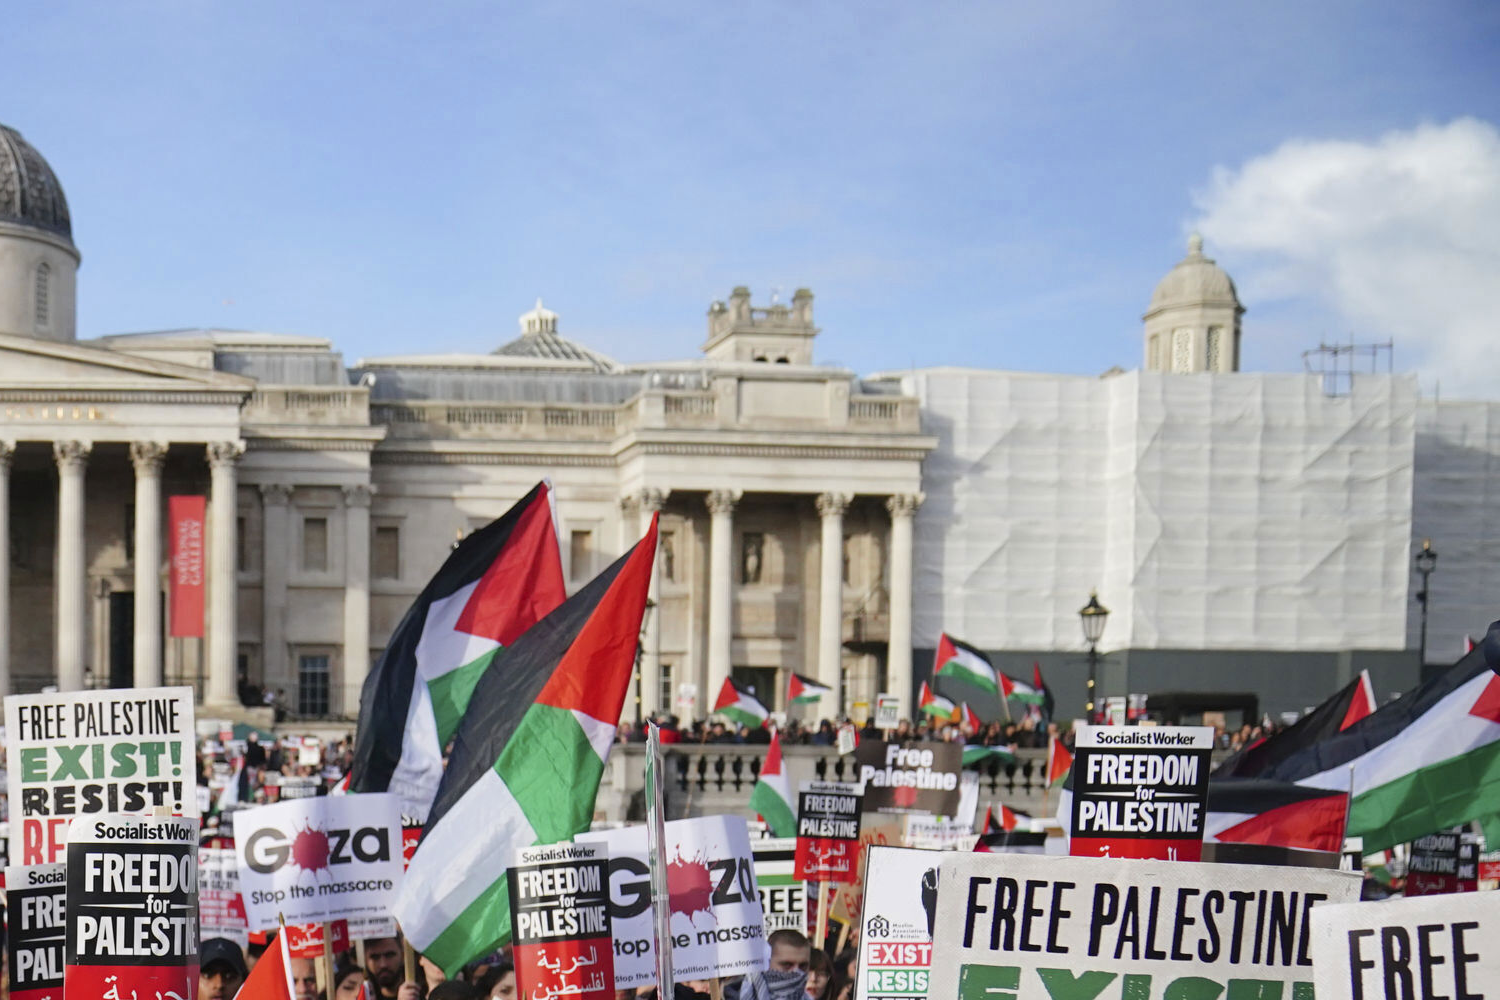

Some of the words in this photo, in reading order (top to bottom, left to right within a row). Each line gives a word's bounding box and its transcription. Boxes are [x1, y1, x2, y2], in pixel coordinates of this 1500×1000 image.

[18, 704, 67, 741] FREE
[74, 698, 180, 738] PALESTINE
[1096, 731, 1152, 745] Socialist
[1153, 732, 1196, 746] Worker
[20, 741, 182, 783] EXIST!
[886, 744, 934, 767] Free
[861, 765, 957, 791] Palestine
[1087, 754, 1199, 786] FREEDOM
[22, 781, 183, 816] RESIST!
[805, 794, 856, 814] FREEDOM
[1136, 785, 1155, 801] for
[800, 817, 857, 838] PALESTINE
[1078, 800, 1200, 833] PALESTINE
[94, 822, 164, 840] Socialist
[244, 826, 390, 875] Gza
[522, 849, 567, 863] Socialist
[568, 847, 595, 860] Worker
[1410, 856, 1457, 874] PALESTINE
[252, 890, 285, 905] Stop
[290, 886, 315, 899] the
[319, 879, 393, 896] massacre
[518, 865, 601, 899] FREEDOM
[609, 856, 756, 919] Gza
[146, 894, 170, 914] for
[559, 894, 576, 909] for
[517, 905, 608, 940] PALESTINE
[962, 876, 1077, 955] FREE
[537, 945, 598, 974] الحرية
[613, 937, 650, 957] top
[868, 943, 931, 965] EXIST
